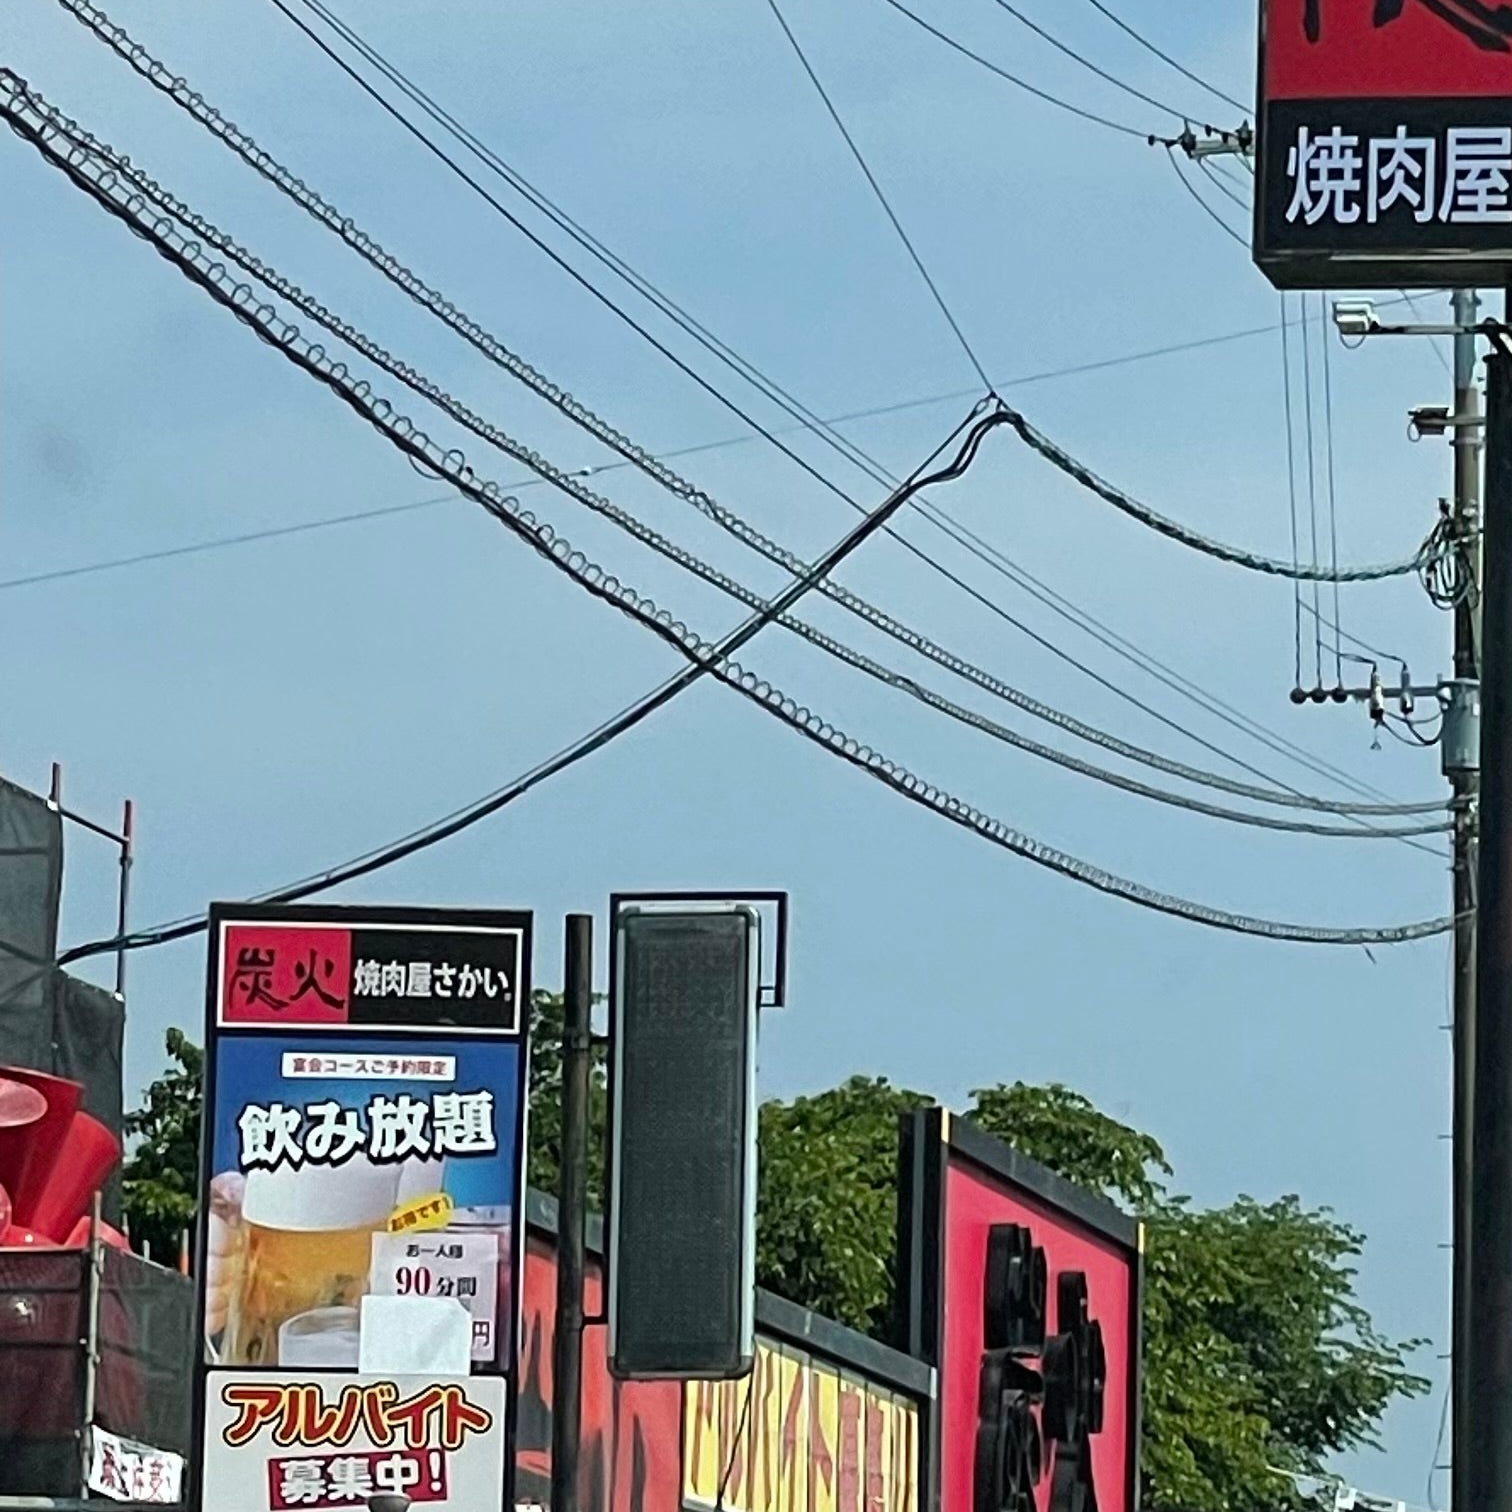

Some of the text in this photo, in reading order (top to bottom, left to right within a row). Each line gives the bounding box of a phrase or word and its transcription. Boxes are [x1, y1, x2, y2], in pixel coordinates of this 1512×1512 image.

[228, 947, 346, 1012] 炭火
[238, 1090, 497, 1168] 飲み放題
[406, 1244, 463, 1259] お一人様
[395, 1266, 477, 1297] 90分間
[222, 1382, 492, 1451] アルバイト
[279, 1451, 442, 1503] 募集中!
